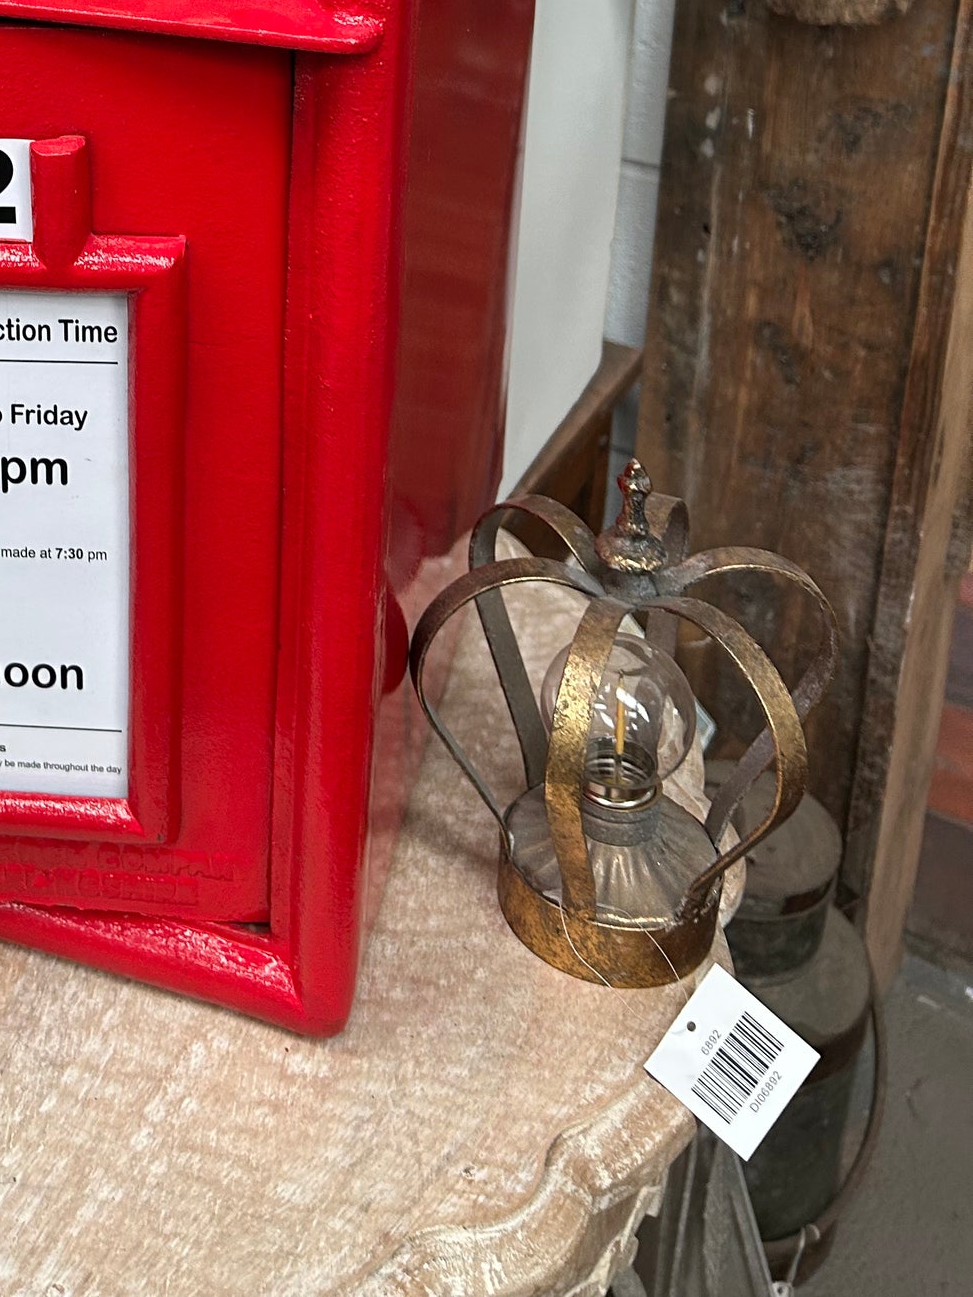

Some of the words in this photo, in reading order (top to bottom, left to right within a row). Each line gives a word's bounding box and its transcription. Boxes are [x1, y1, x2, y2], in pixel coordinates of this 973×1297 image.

[58, 319, 118, 343] Time
[11, 404, 88, 431] Friday
[0, 546, 36, 559] made
[40, 548, 52, 560] at
[56, 548, 83, 560] 7:30
[88, 550, 107, 563] pm
[4, 759, 15, 768] be
[17, 761, 42, 769] made
[43, 762, 88, 772] throughout
[91, 764, 104, 773] the
[106, 765, 122, 775] day
[700, 1029, 722, 1056] 6892
